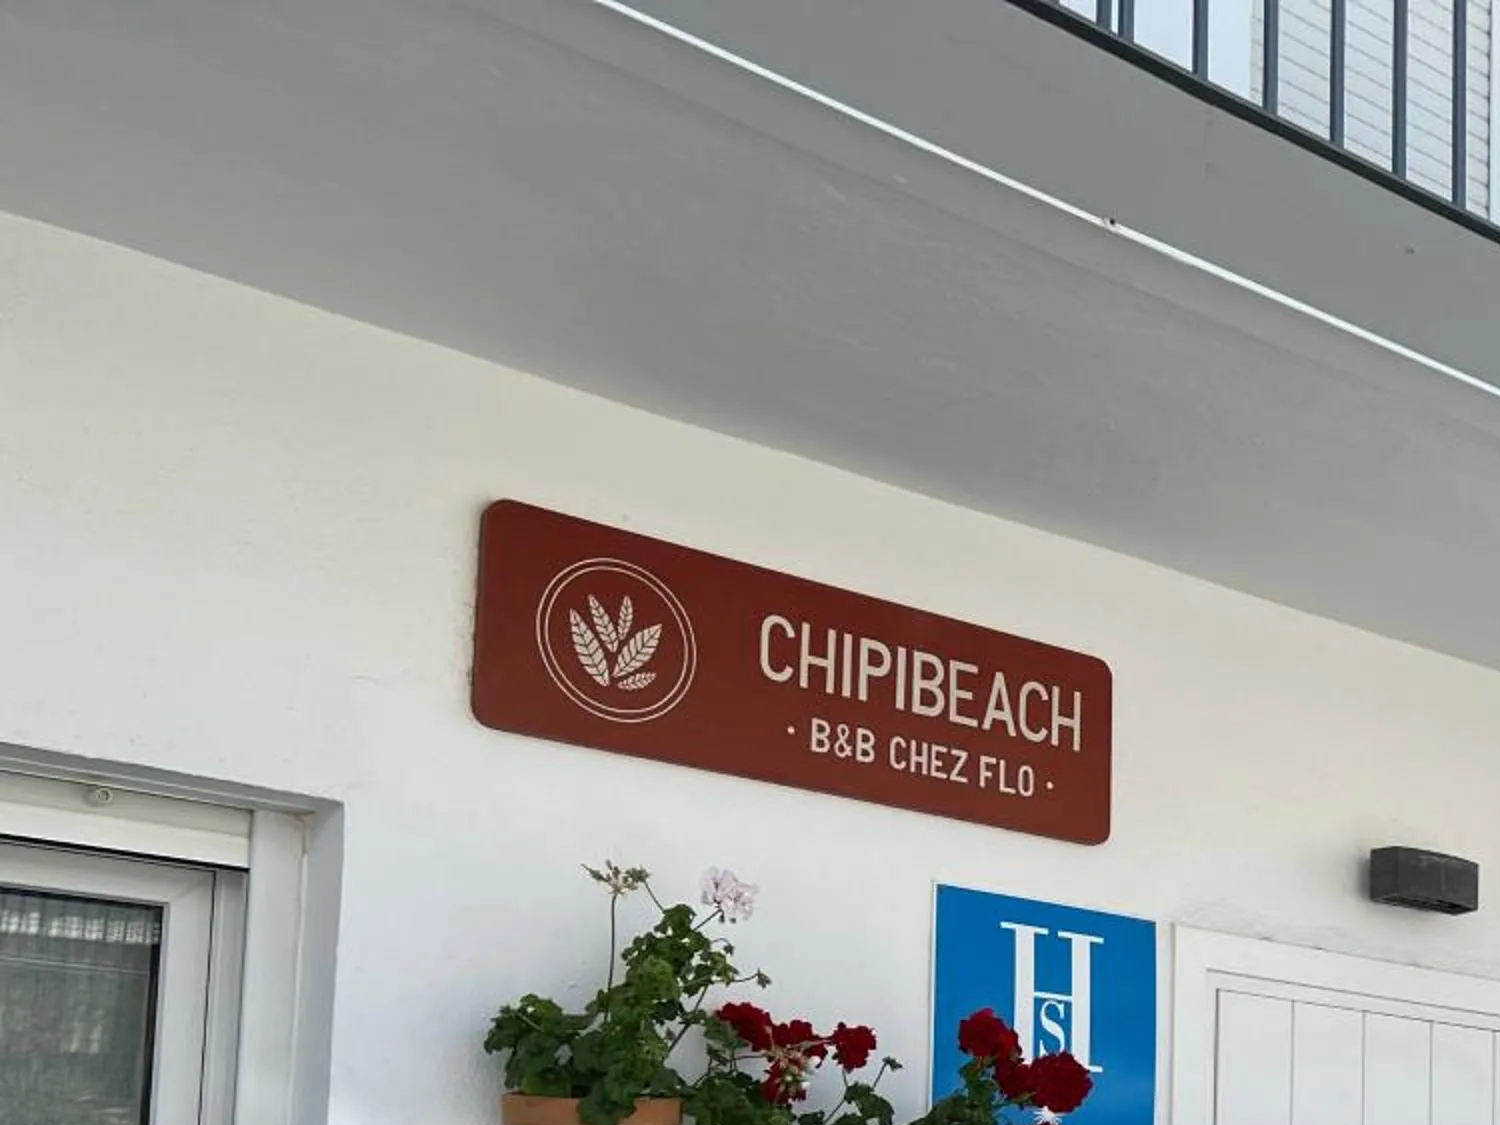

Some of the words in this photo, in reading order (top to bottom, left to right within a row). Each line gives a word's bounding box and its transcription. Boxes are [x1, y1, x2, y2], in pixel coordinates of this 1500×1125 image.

[760, 614, 1082, 752] CHIPIBEACH
[811, 718, 876, 763] B&B
[890, 736, 969, 783] CHEZ
[980, 755, 1034, 797] FLO
